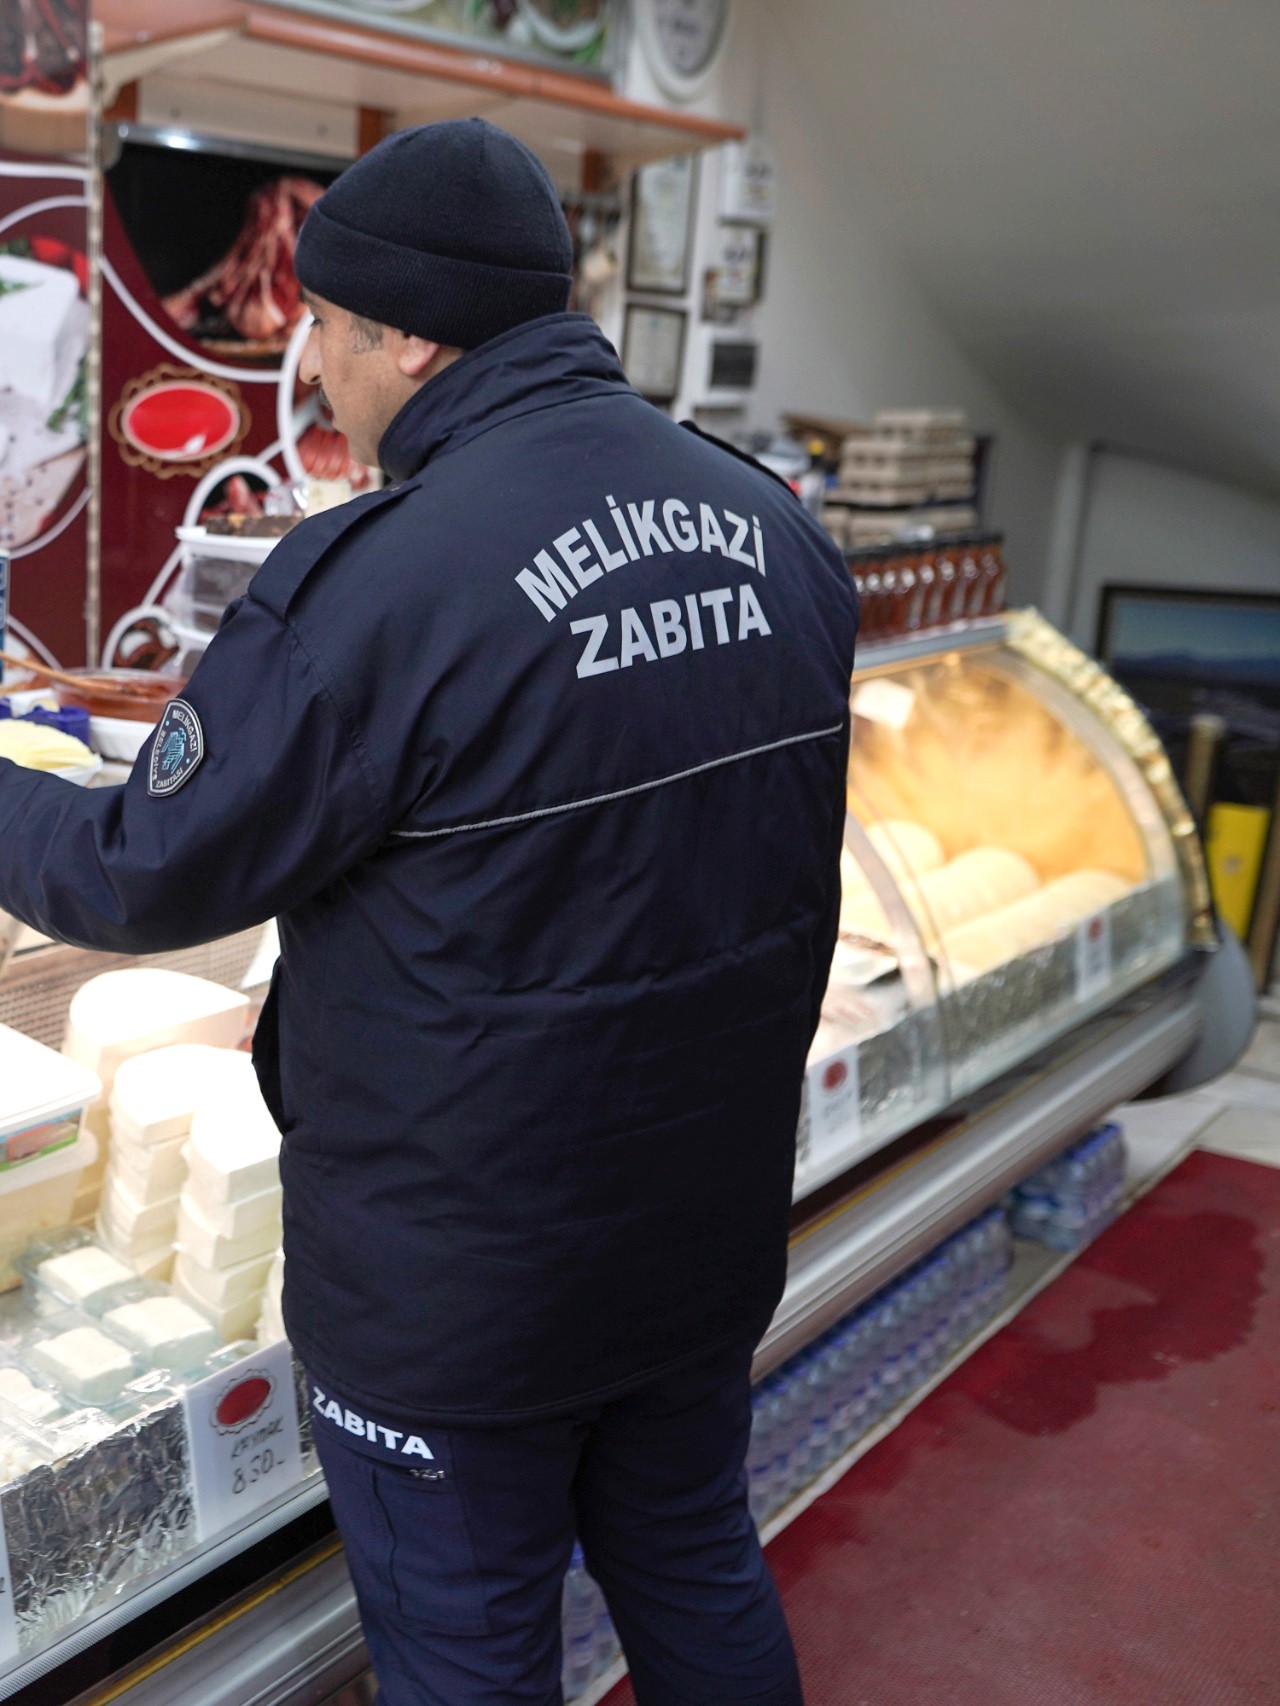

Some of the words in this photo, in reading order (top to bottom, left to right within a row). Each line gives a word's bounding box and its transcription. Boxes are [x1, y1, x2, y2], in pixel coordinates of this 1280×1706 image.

[515, 495, 766, 622] MELİKGAZİ
[570, 584, 772, 679] ZABITA
[312, 1386, 435, 1460] ZABITA
